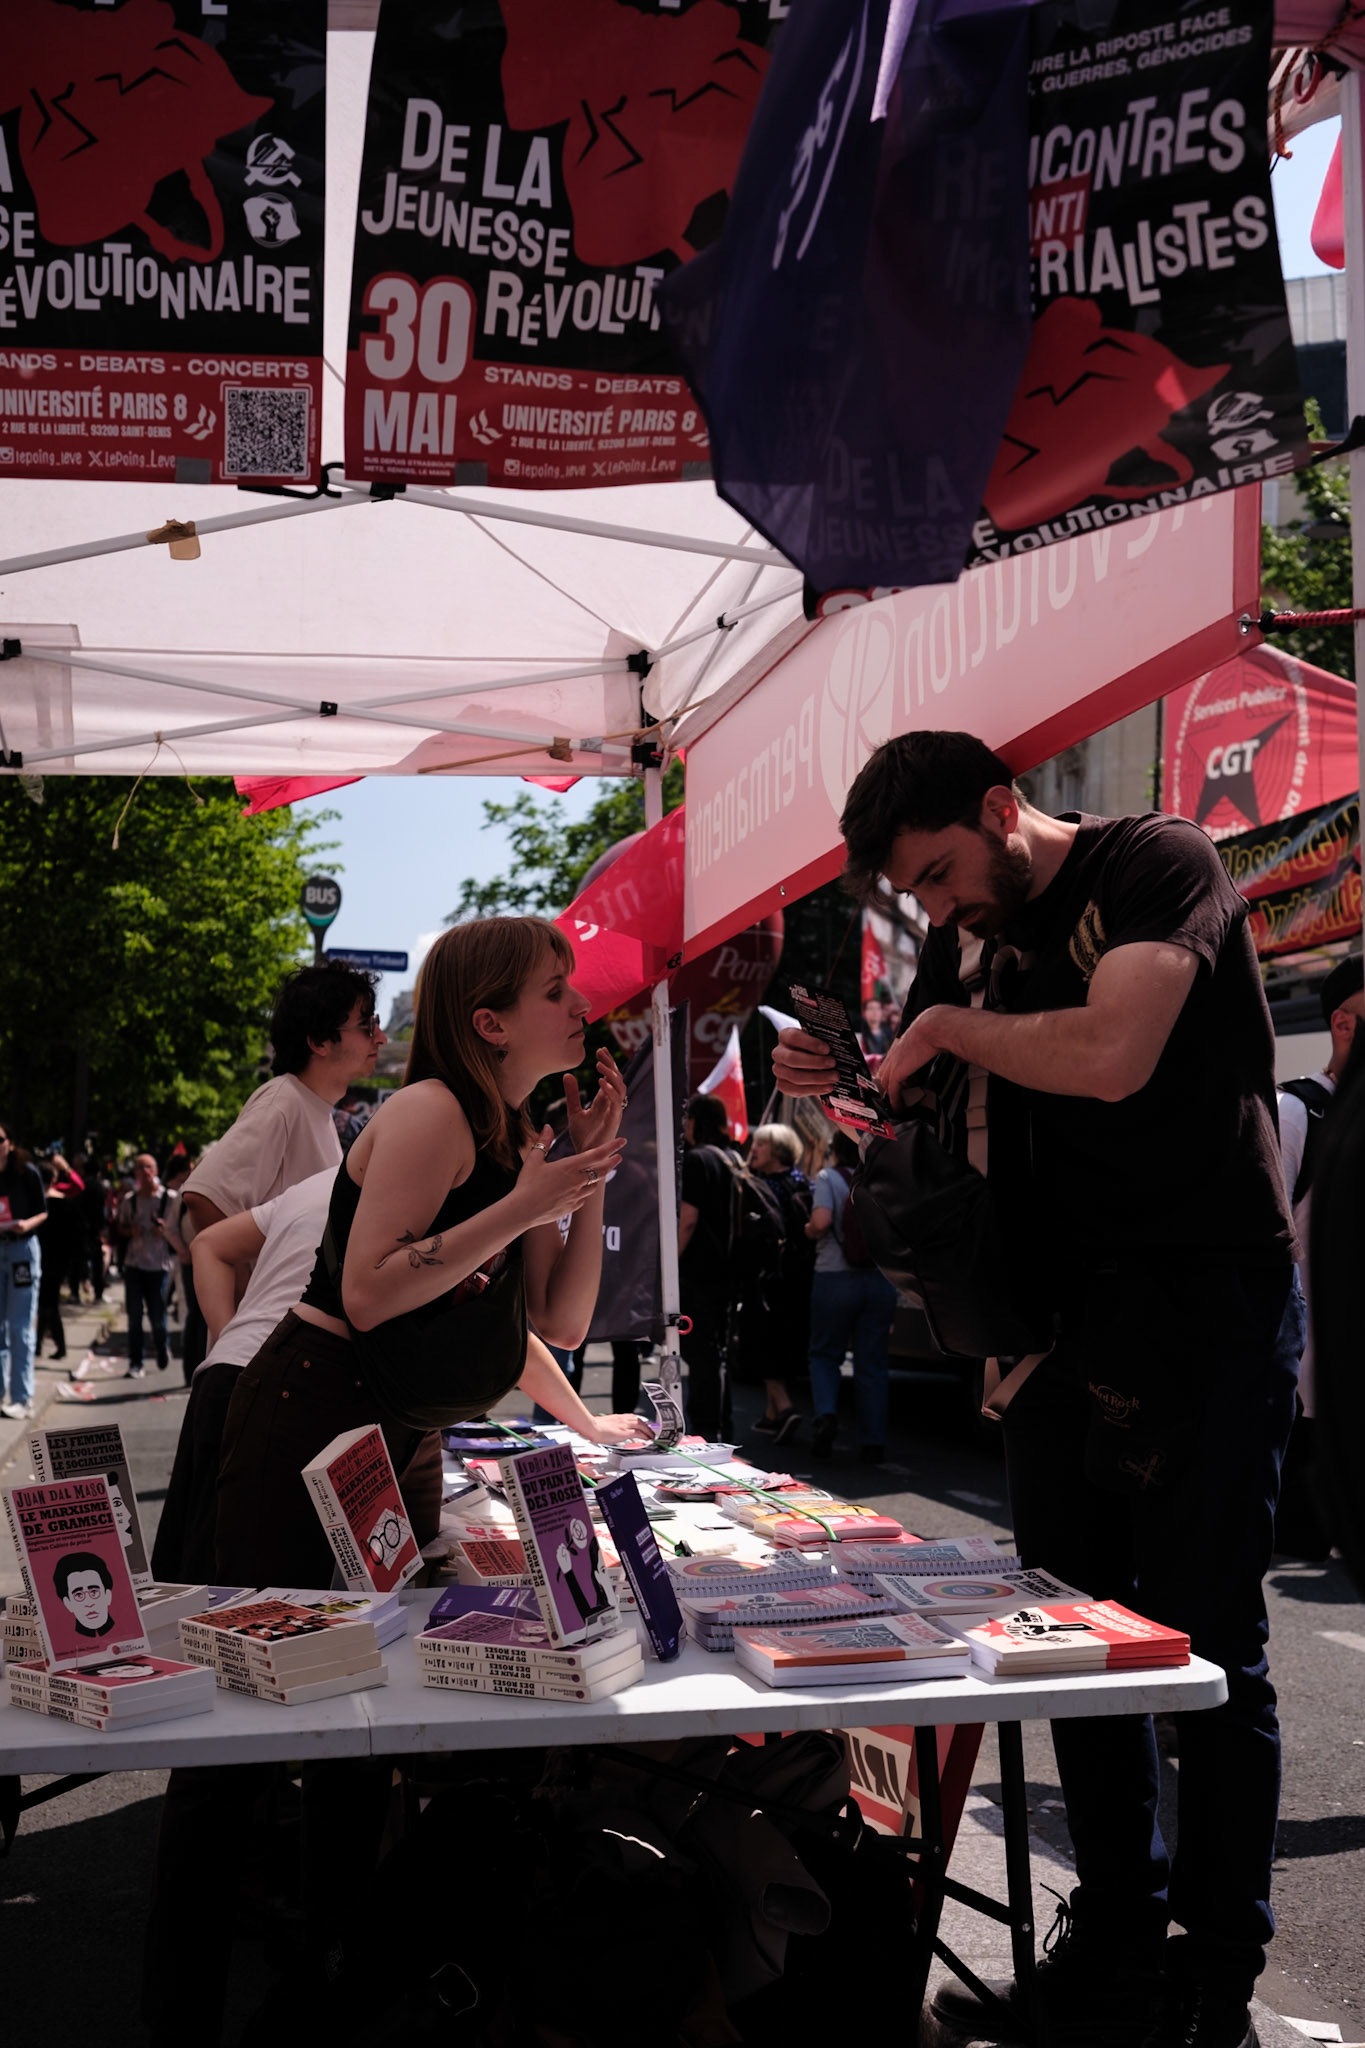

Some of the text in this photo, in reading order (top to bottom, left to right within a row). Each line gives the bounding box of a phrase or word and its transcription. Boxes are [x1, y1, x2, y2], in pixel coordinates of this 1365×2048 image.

[1069, 46, 1090, 66] LA
[1096, 23, 1176, 58] RIPOSTE
[1180, 8, 1231, 35] FACE
[1041, 57, 1132, 93] GUERRES,
[400, 97, 552, 209] DE LA
[361, 172, 571, 278] JEUNESSE
[1029, 190, 1086, 243] NTI
[365, 277, 472, 383] 30
[80, 355, 166, 375] DEBATS
[188, 359, 309, 379] CONCERTS
[484, 366, 681, 396] STANDS DEBATS
[109, 391, 168, 420] PARIS
[174, 393, 188, 420] 8
[29, 424, 39, 435] DE
[41, 424, 52, 435] LA
[363, 388, 458, 456] MAI
[502, 403, 697, 437] UNIVERSITÉ PARIS 8
[1206, 739, 1260, 780] CGT
[305, 886, 337, 905] BUS
[47, 1431, 121, 1449] LES FEMMES
[51, 1443, 123, 1460] LA RÉVOLUTION
[53, 1452, 126, 1470] LE SOCIALISME
[17, 1482, 106, 1508] JUAN DAL MASO
[522, 1470, 578, 1496] DU PAIN ET
[526, 1484, 582, 1510] DES ROSES
[20, 1501, 110, 1522] LE MARXISME
[23, 1513, 113, 1536] DE GRAMSCI
[330, 1527, 353, 1579] MARXISME,
[523, 1540, 530, 1551] ET
[528, 1539, 541, 1568] ROSES
[356, 1564, 364, 1576] ART
[525, 1551, 537, 1575] PAIN
[532, 1575, 540, 1588] DU
[484, 1646, 509, 1655] ROSES
[489, 1663, 513, 1671] ROSES
